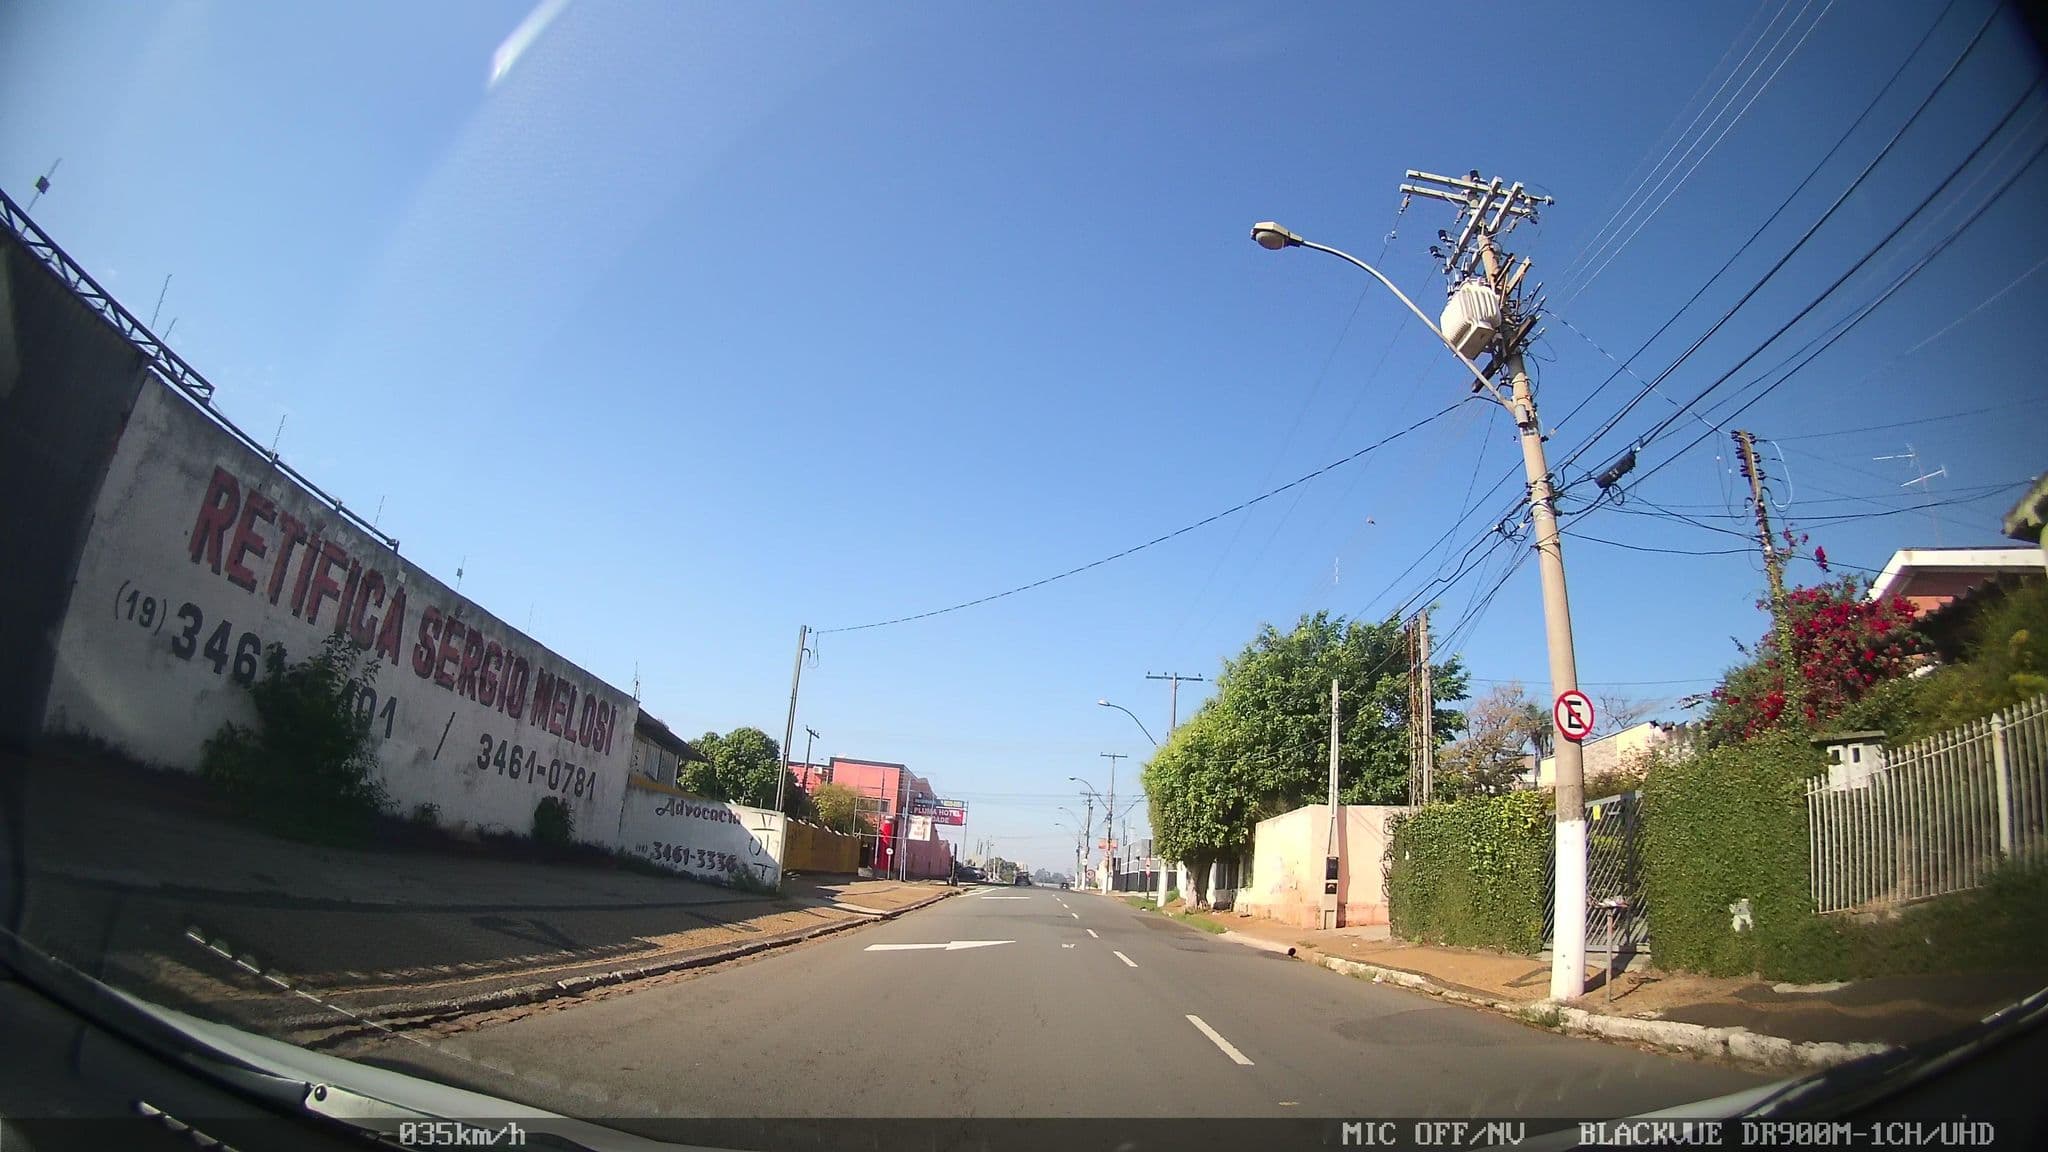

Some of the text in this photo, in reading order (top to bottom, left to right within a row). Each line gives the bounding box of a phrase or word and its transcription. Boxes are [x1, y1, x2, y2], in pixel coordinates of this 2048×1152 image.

[115, 579, 167, 637] (19)
[477, 733, 596, 800] 3461-0781
[530, 666, 617, 756] MELOSI
[1567, 700, 1582, 729] E
[655, 798, 742, 825] Advocacia
[938, 808, 961, 817] HOTEL
